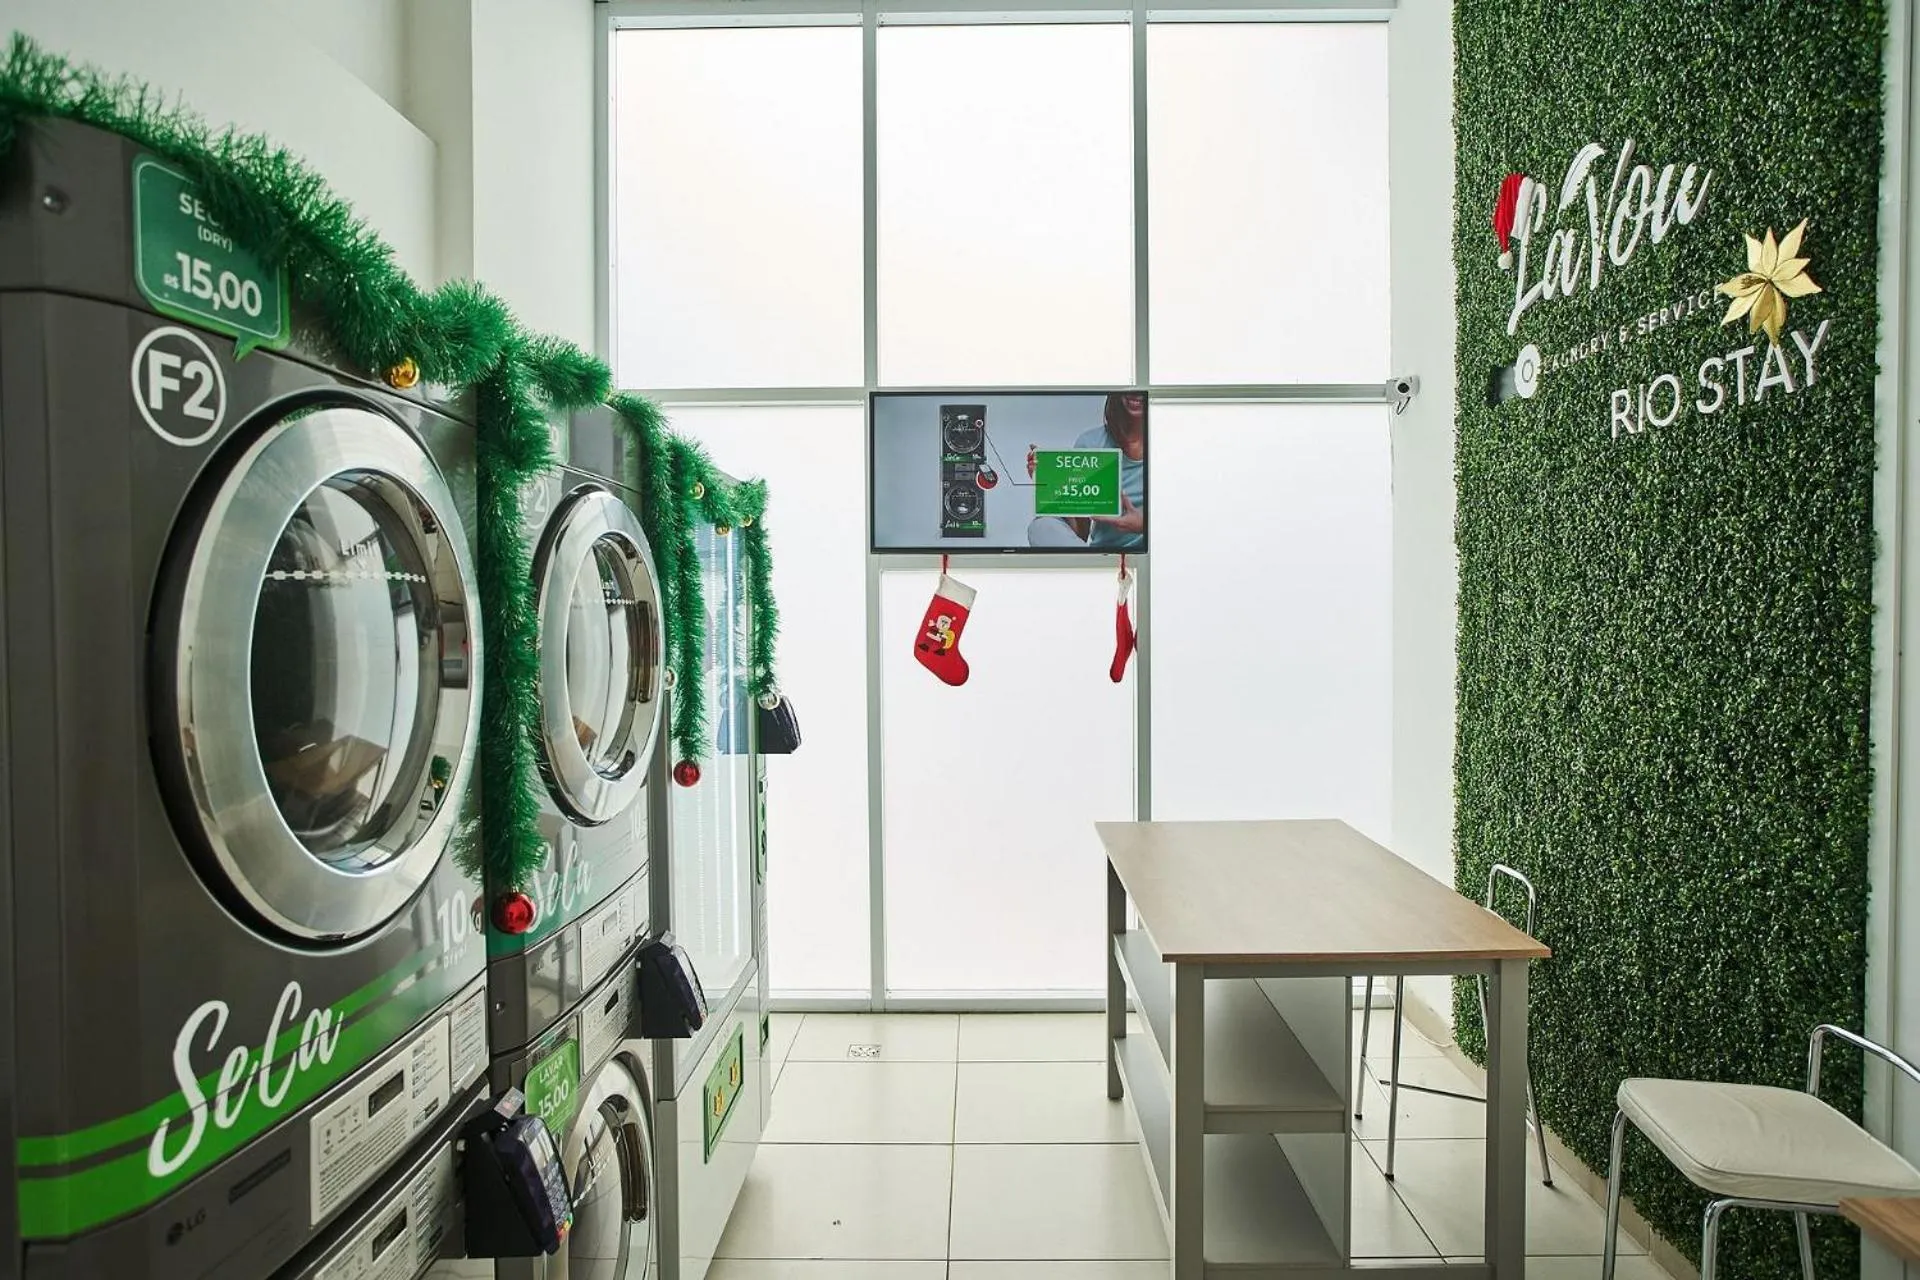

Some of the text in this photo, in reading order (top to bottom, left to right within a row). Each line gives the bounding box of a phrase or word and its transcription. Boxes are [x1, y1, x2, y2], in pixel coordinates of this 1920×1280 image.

[197, 225, 233, 253] (DRY)
[176, 251, 263, 318] 15,00
[147, 348, 216, 420] F2
[1610, 320, 1832, 439] RIO STAY
[1055, 455, 1099, 468] SECAR
[1062, 485, 1100, 497] 15,00
[148, 981, 345, 1178] SeCa
